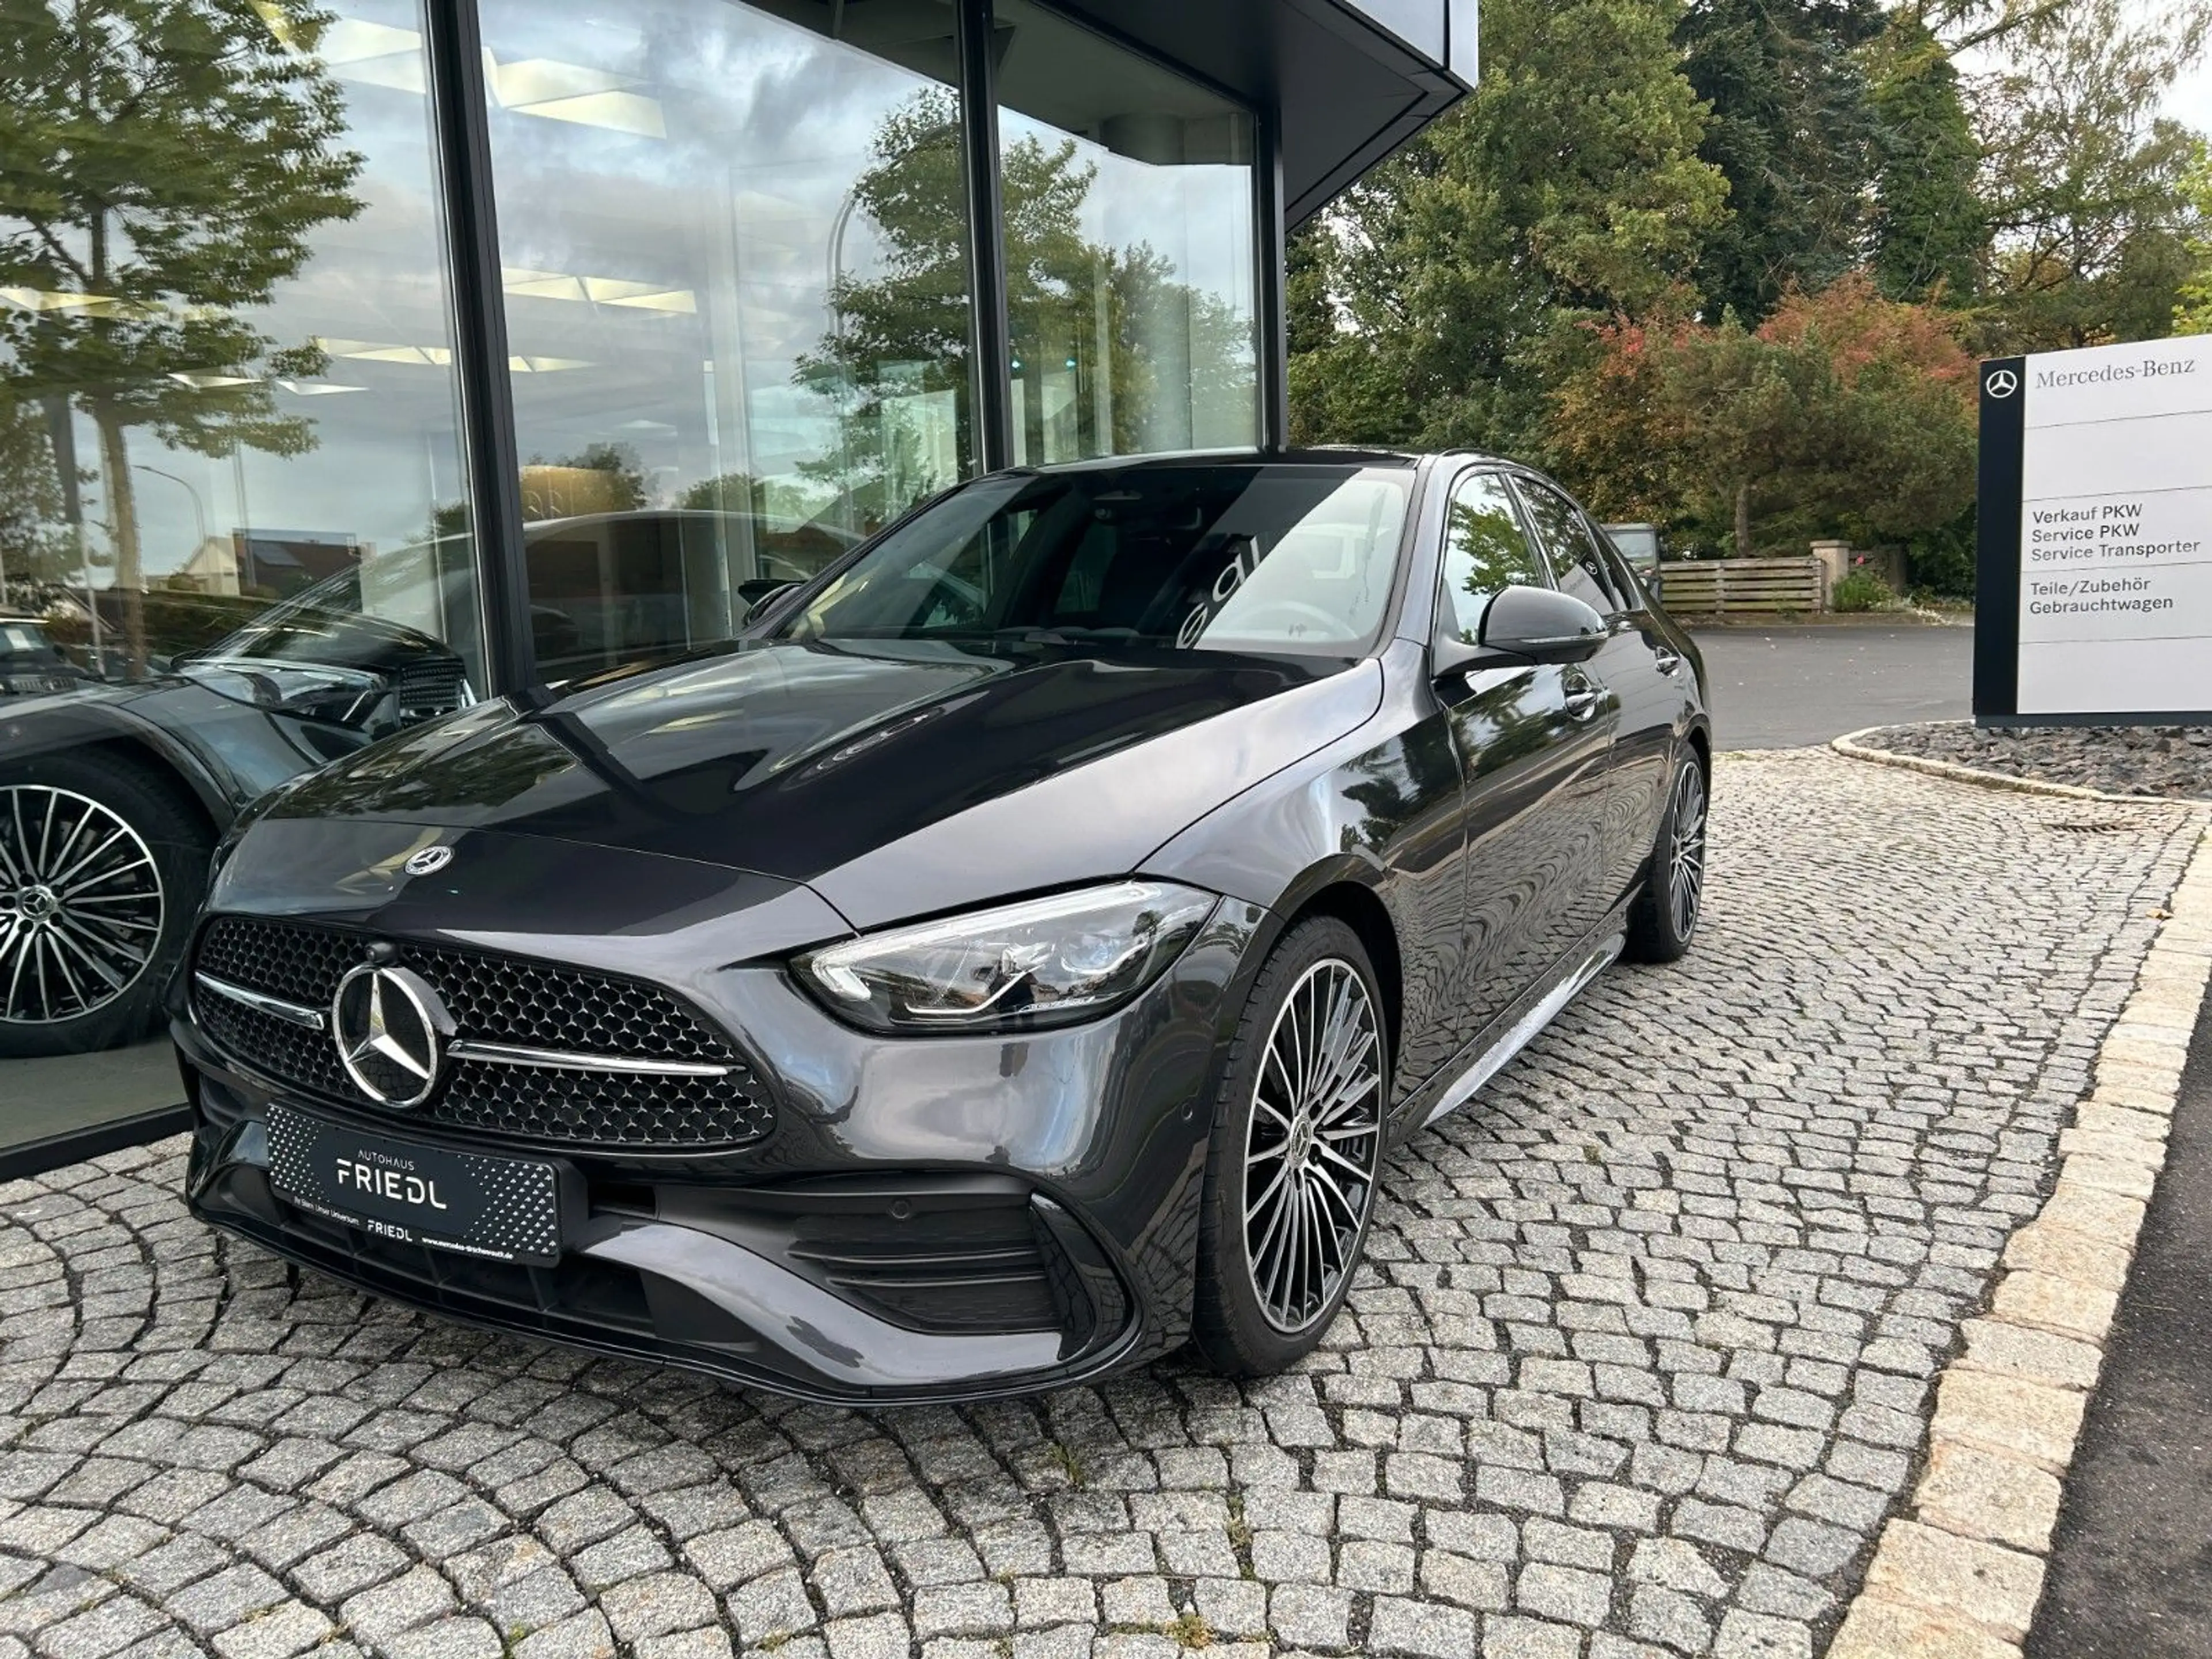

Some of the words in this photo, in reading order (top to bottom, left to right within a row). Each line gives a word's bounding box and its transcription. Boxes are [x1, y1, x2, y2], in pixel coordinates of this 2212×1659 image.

[2035, 359, 2195, 388] Mercedes-Benz
[2033, 506, 2097, 524] Verkauf
[2103, 503, 2142, 519] PKW
[2032, 527, 2094, 543] Service
[2100, 523, 2140, 539] PKW
[2032, 547, 2093, 561] Service
[2099, 540, 2200, 558] Transporter
[2031, 578, 2151, 596] Teile/Zubehör
[2029, 598, 2173, 615] Gebrauchtwagen
[358, 1149, 415, 1171] AUTOHAUS
[336, 1158, 447, 1210] FRIEDL
[367, 1219, 413, 1243] FRIEDL
